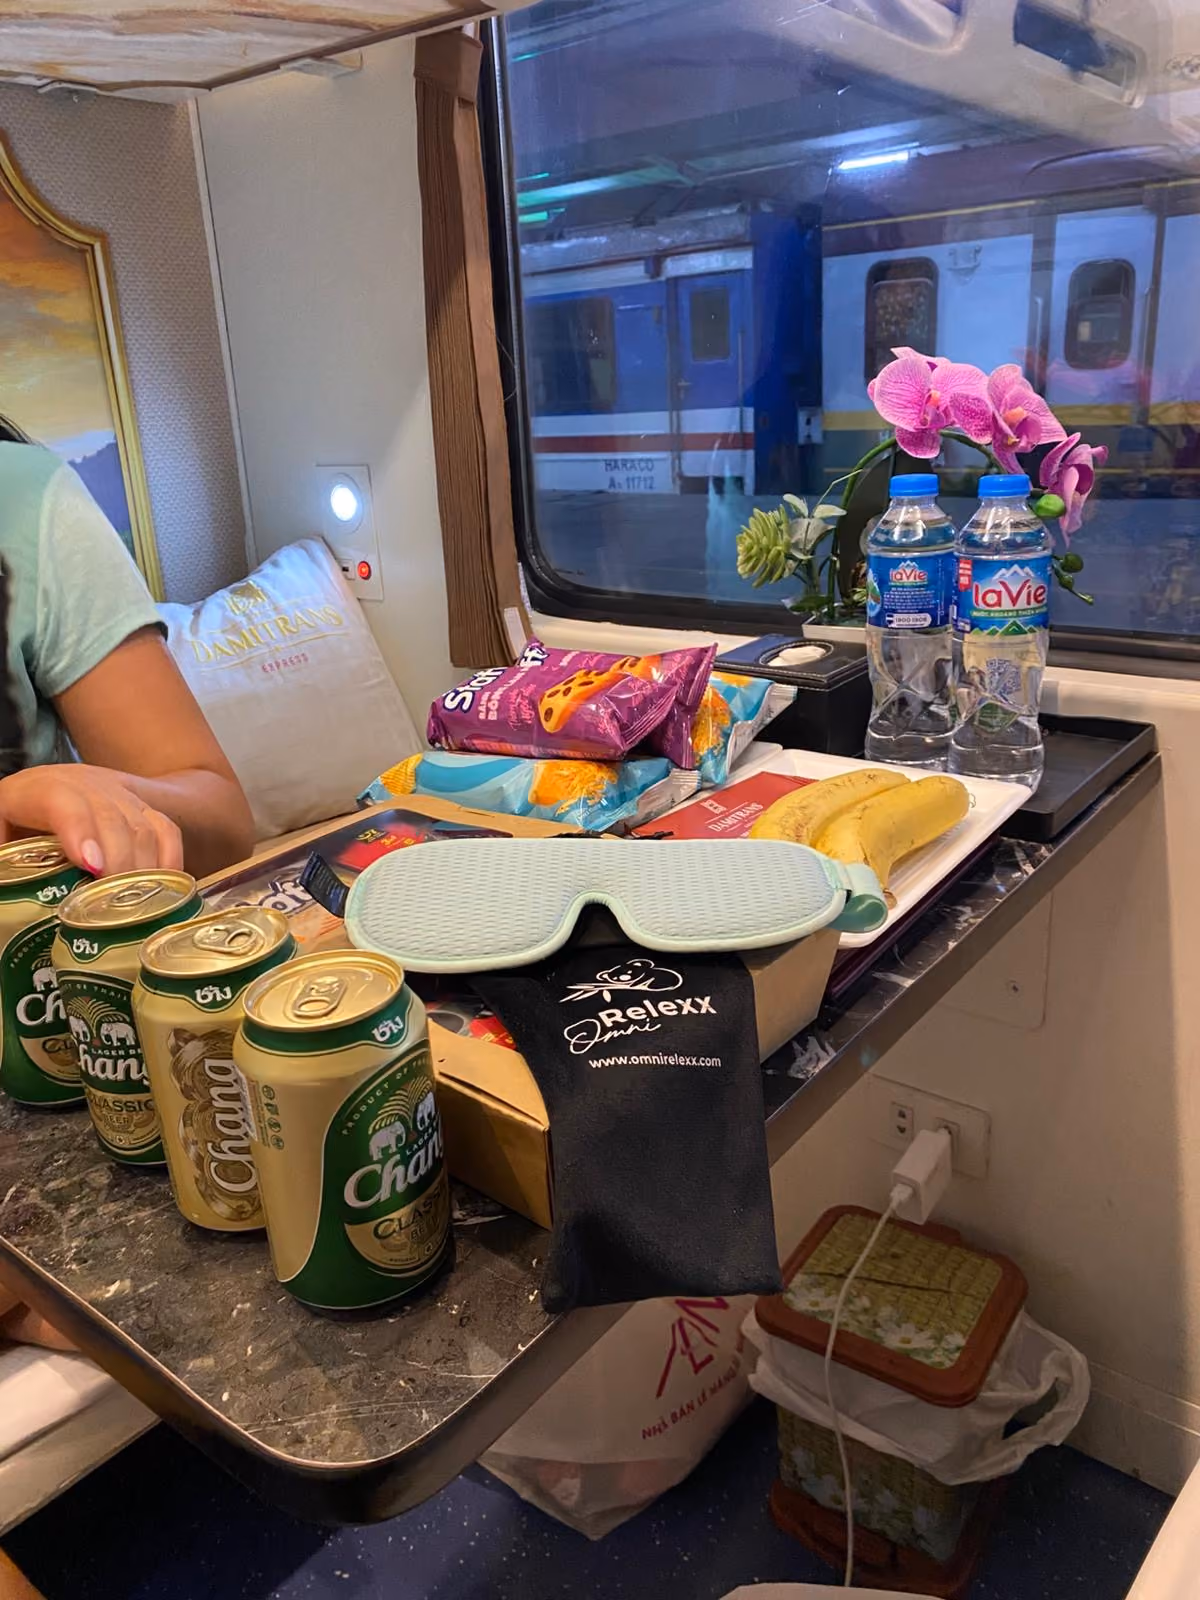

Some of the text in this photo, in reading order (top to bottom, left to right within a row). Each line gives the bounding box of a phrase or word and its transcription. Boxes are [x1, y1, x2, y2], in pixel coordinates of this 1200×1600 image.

[604, 458, 655, 473] HARACO
[972, 578, 1047, 609] laVie
[190, 604, 344, 664] DAMITRANS
[260, 652, 309, 673] EXPRESS
[598, 996, 718, 1028] Relexx
[563, 1017, 662, 1055] Omni
[588, 1052, 723, 1069] www.omnirelexx.com
[343, 1118, 444, 1209] Chan
[373, 1191, 442, 1240] CLASS
